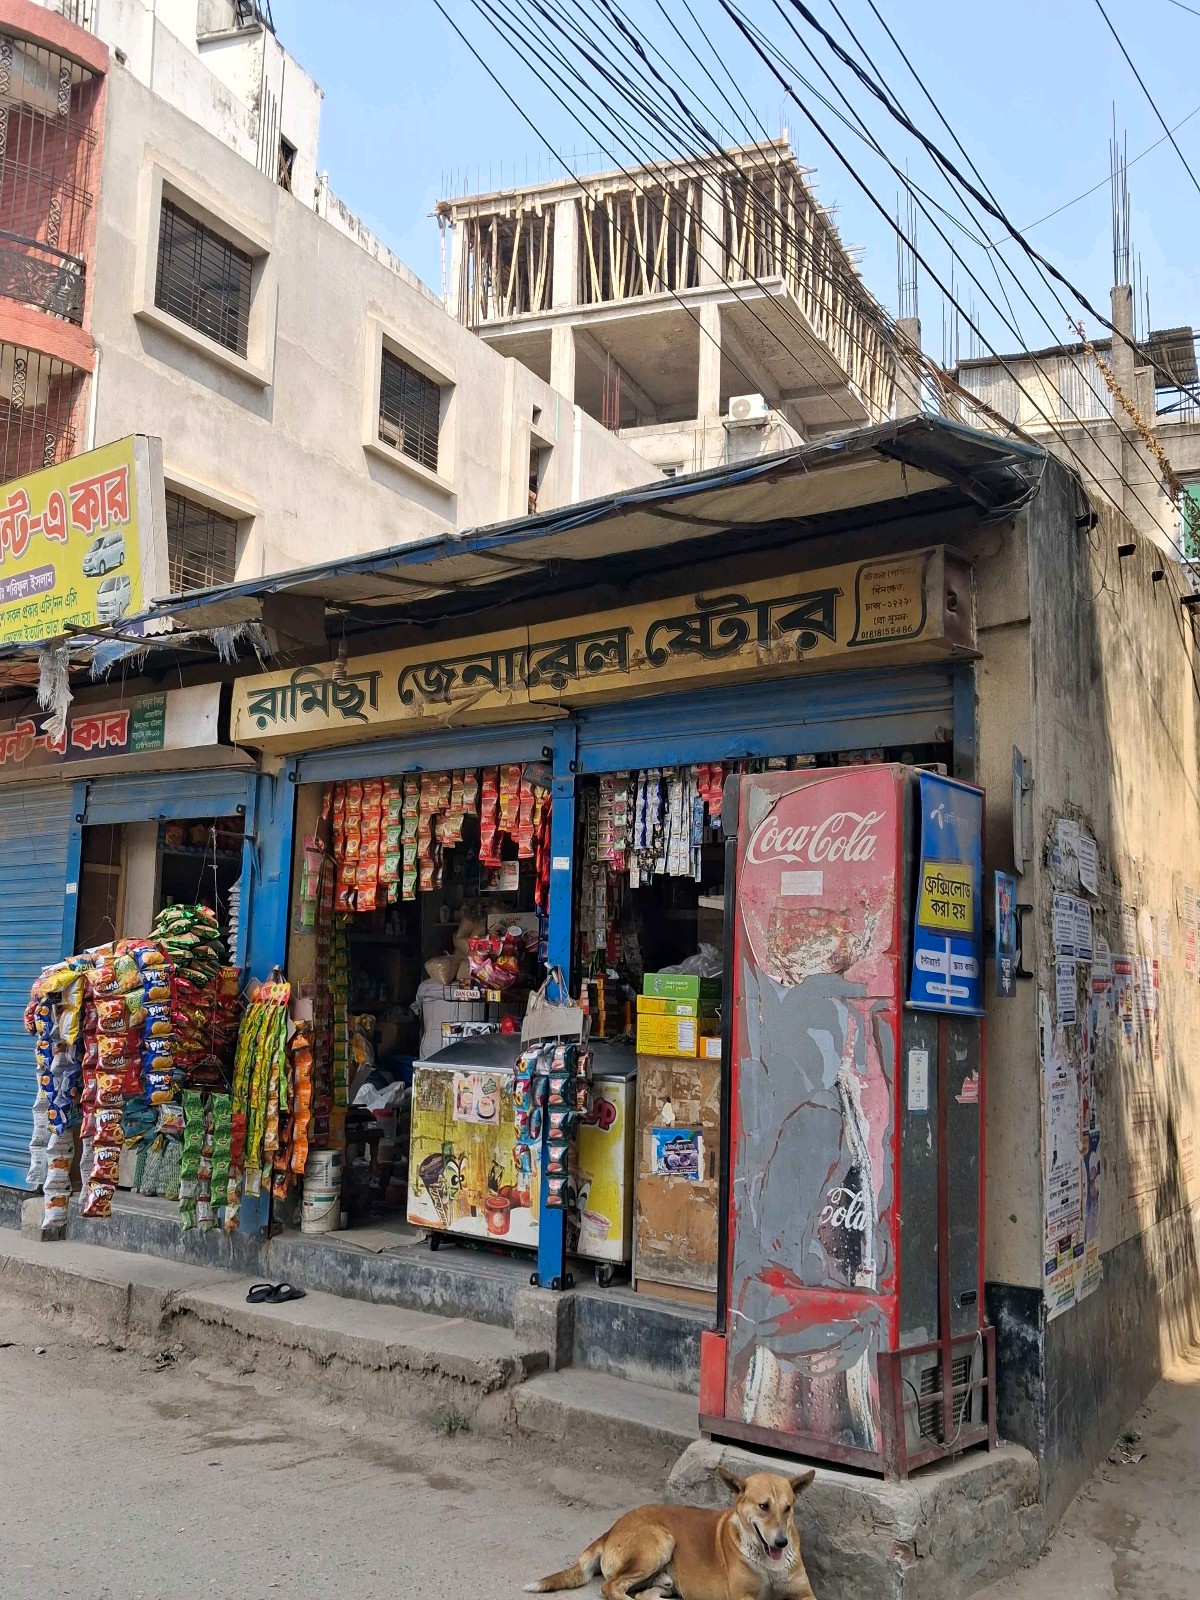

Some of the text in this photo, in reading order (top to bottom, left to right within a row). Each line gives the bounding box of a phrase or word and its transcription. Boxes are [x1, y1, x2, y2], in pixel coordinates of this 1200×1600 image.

[68, 464, 130, 535] কার
[6, 578, 29, 597] শরিফুল
[29, 571, 54, 591] ইসলাম
[398, 626, 634, 705] জেনারেল
[71, 709, 131, 751] কার
[747, 811, 886, 864] Coca-Cola
[931, 899, 966, 920] করা হয়
